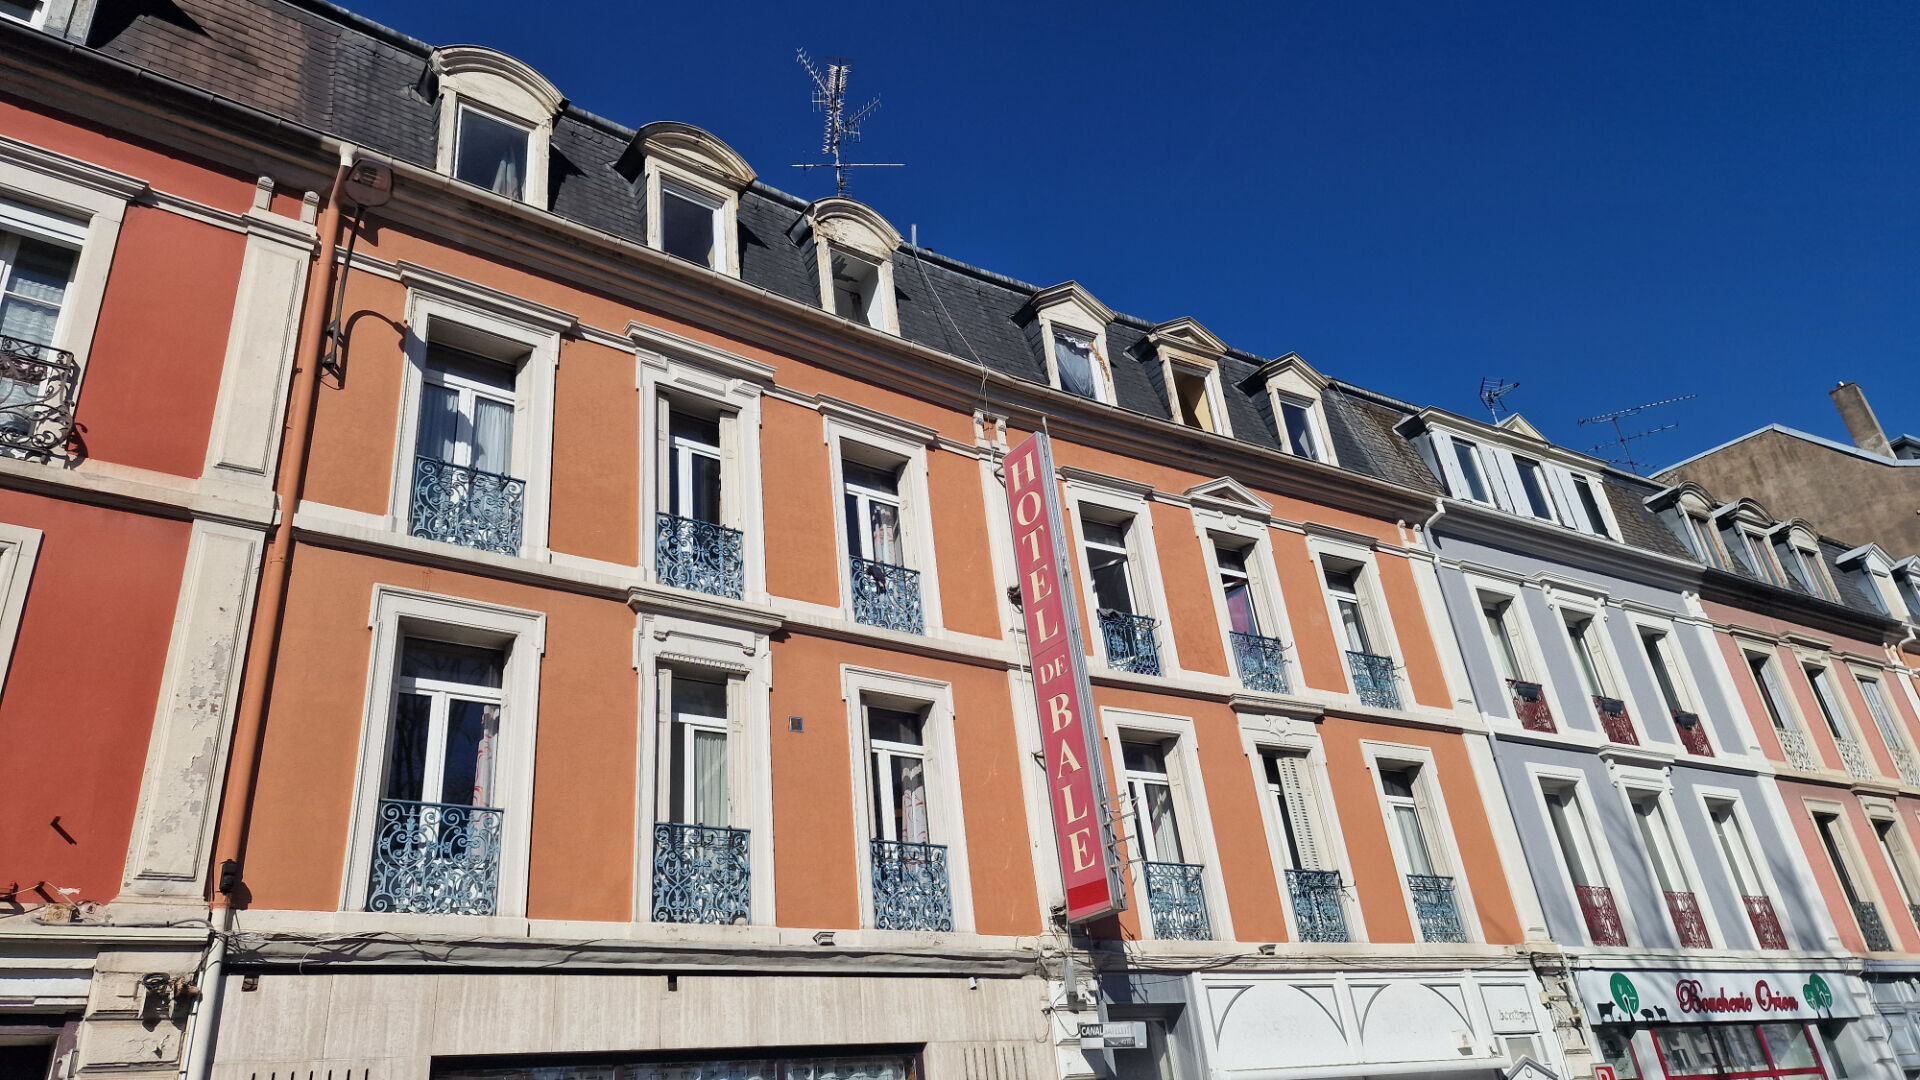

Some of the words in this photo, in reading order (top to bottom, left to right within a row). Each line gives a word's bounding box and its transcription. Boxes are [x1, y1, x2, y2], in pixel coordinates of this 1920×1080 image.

[1010, 449, 1059, 646] HOTEL
[1039, 654, 1068, 686] DE
[1047, 692, 1096, 873] BALE
[1675, 978, 1753, 1014] Boucherie
[1754, 979, 1799, 1012] Orion
